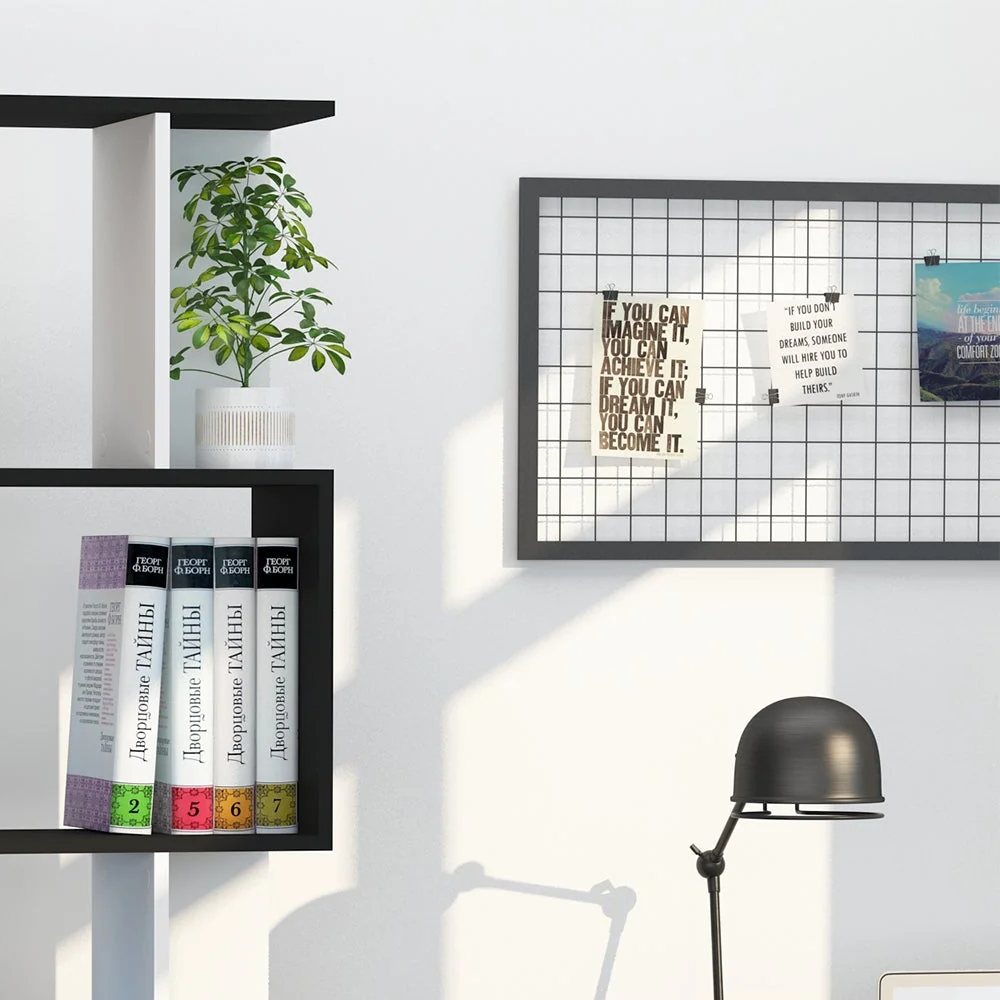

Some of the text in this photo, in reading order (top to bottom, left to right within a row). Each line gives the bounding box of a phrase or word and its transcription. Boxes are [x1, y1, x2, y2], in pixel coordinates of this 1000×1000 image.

[602, 301, 690, 324] IF YOU CAN
[797, 304, 812, 315] YOU
[957, 303, 1000, 316] life begin
[790, 318, 833, 331] BUILD YOUR
[958, 315, 969, 332] AT
[971, 315, 985, 332] THE
[602, 319, 690, 345] IMAGINE IT,
[964, 333, 996, 345] of your
[602, 338, 668, 360] YOU CAN
[779, 333, 847, 349] DREAMS, SOMEONE
[782, 348, 848, 364] WILL HIRE YOU TO
[956, 344, 988, 359] COMFORT
[600, 357, 689, 381] ACHIEVE IT;
[795, 366, 837, 379] HELP BUILD
[599, 376, 685, 399] IF YOU CAN
[599, 395, 679, 420] DREAM IT,
[599, 413, 664, 434] YOU CAN
[598, 431, 684, 454] BECOME IT.
[136, 556, 162, 566] ГЕОРГ
[177, 557, 208, 567] ГЕОРГ
[222, 558, 248, 567] ГЕОРГ
[266, 557, 291, 567] ГЕОРГ
[129, 602, 155, 762] Дворцовые ТАЙНЫ
[178, 604, 207, 764] Дворцовые ТАЙНЫ
[224, 604, 248, 764] Дворцовые ТАЙНЫ
[267, 605, 290, 761] Дворцовые ТАЙНЫ
[128, 798, 140, 814] 2
[187, 801, 200, 817] 5
[230, 801, 241, 816] 6
[273, 797, 282, 813] 7
